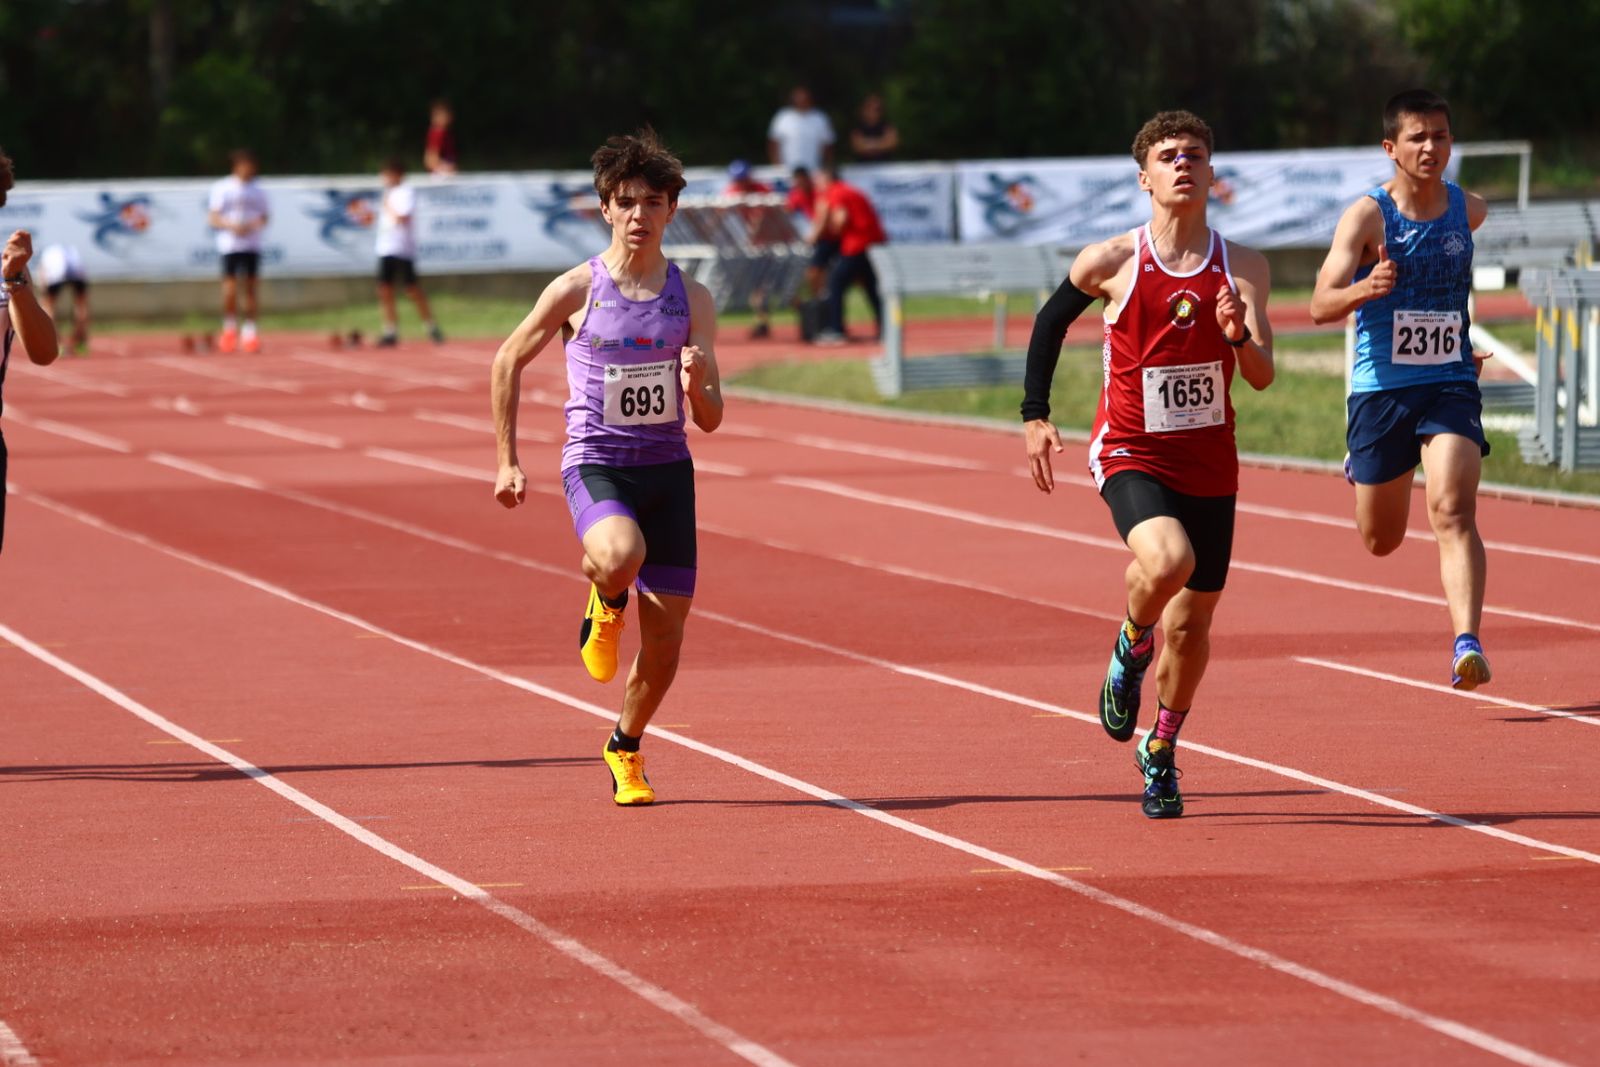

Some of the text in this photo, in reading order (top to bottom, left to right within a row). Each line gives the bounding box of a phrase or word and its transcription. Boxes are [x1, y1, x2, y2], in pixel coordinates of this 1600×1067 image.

[1396, 326, 1455, 356] 2316
[620, 384, 665, 418] 693
[1158, 376, 1214, 409] 1653
